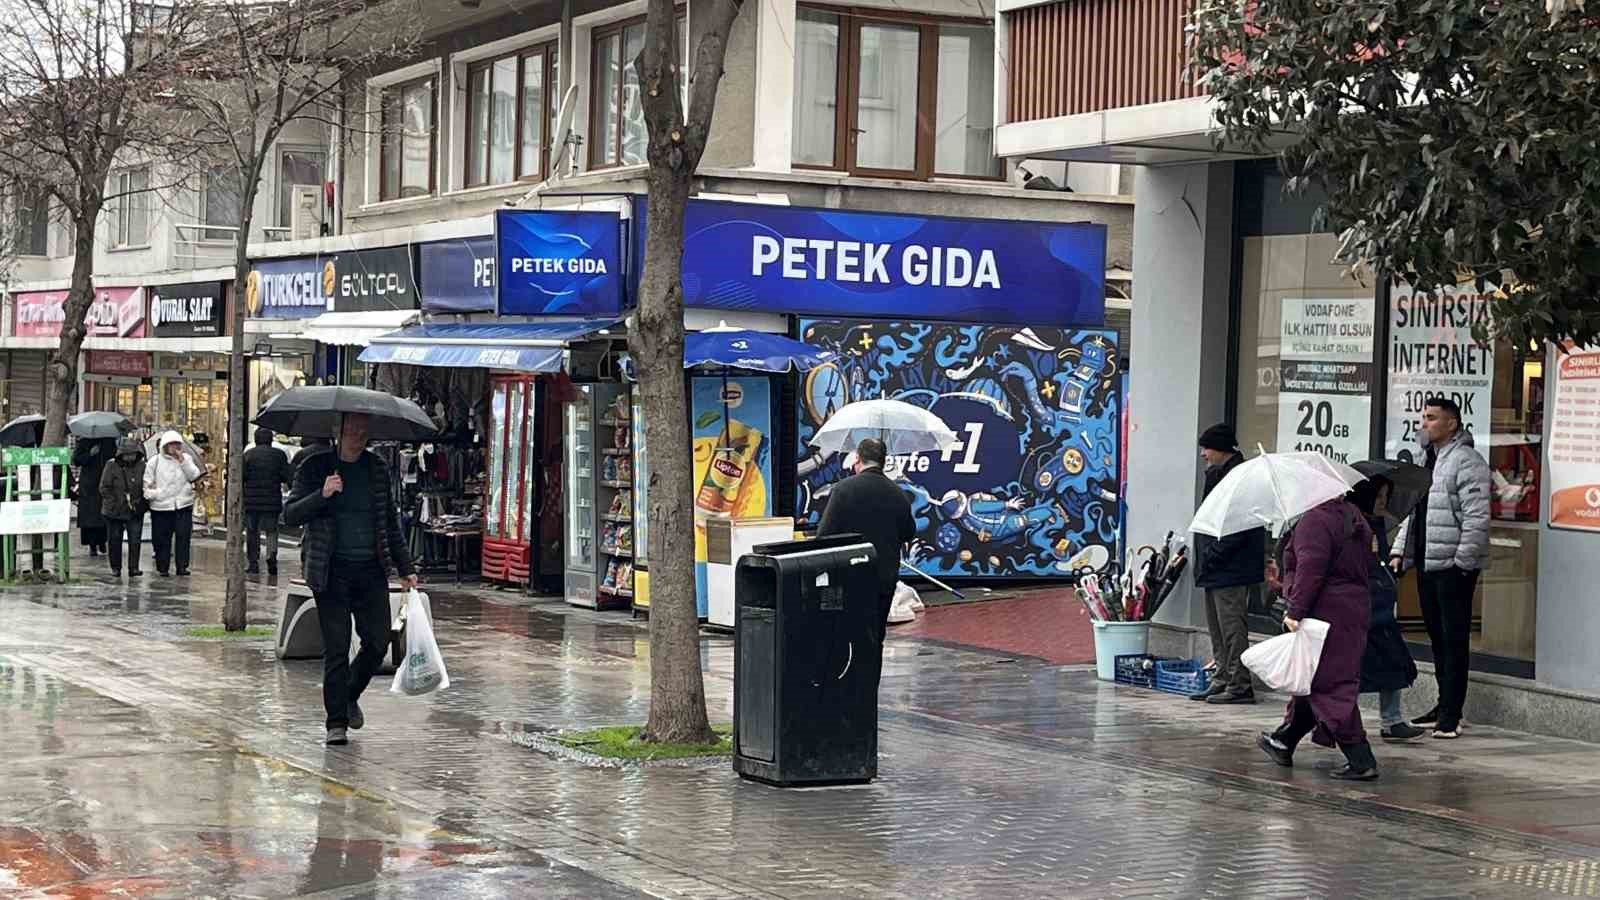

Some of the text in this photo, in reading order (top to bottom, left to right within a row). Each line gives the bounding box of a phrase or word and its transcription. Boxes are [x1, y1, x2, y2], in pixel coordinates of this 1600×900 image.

[511, 257, 608, 274] PETEK GIDA
[751, 234, 1001, 290] PETEK GIDA
[263, 271, 326, 307] TURKCELL
[159, 299, 188, 323] VURAL
[189, 296, 214, 322] SAAT
[1304, 303, 1356, 317] VODAFONE
[1284, 320, 1373, 338] İLK HATTIM OLSUN
[1394, 335, 1488, 376] İNTERNET
